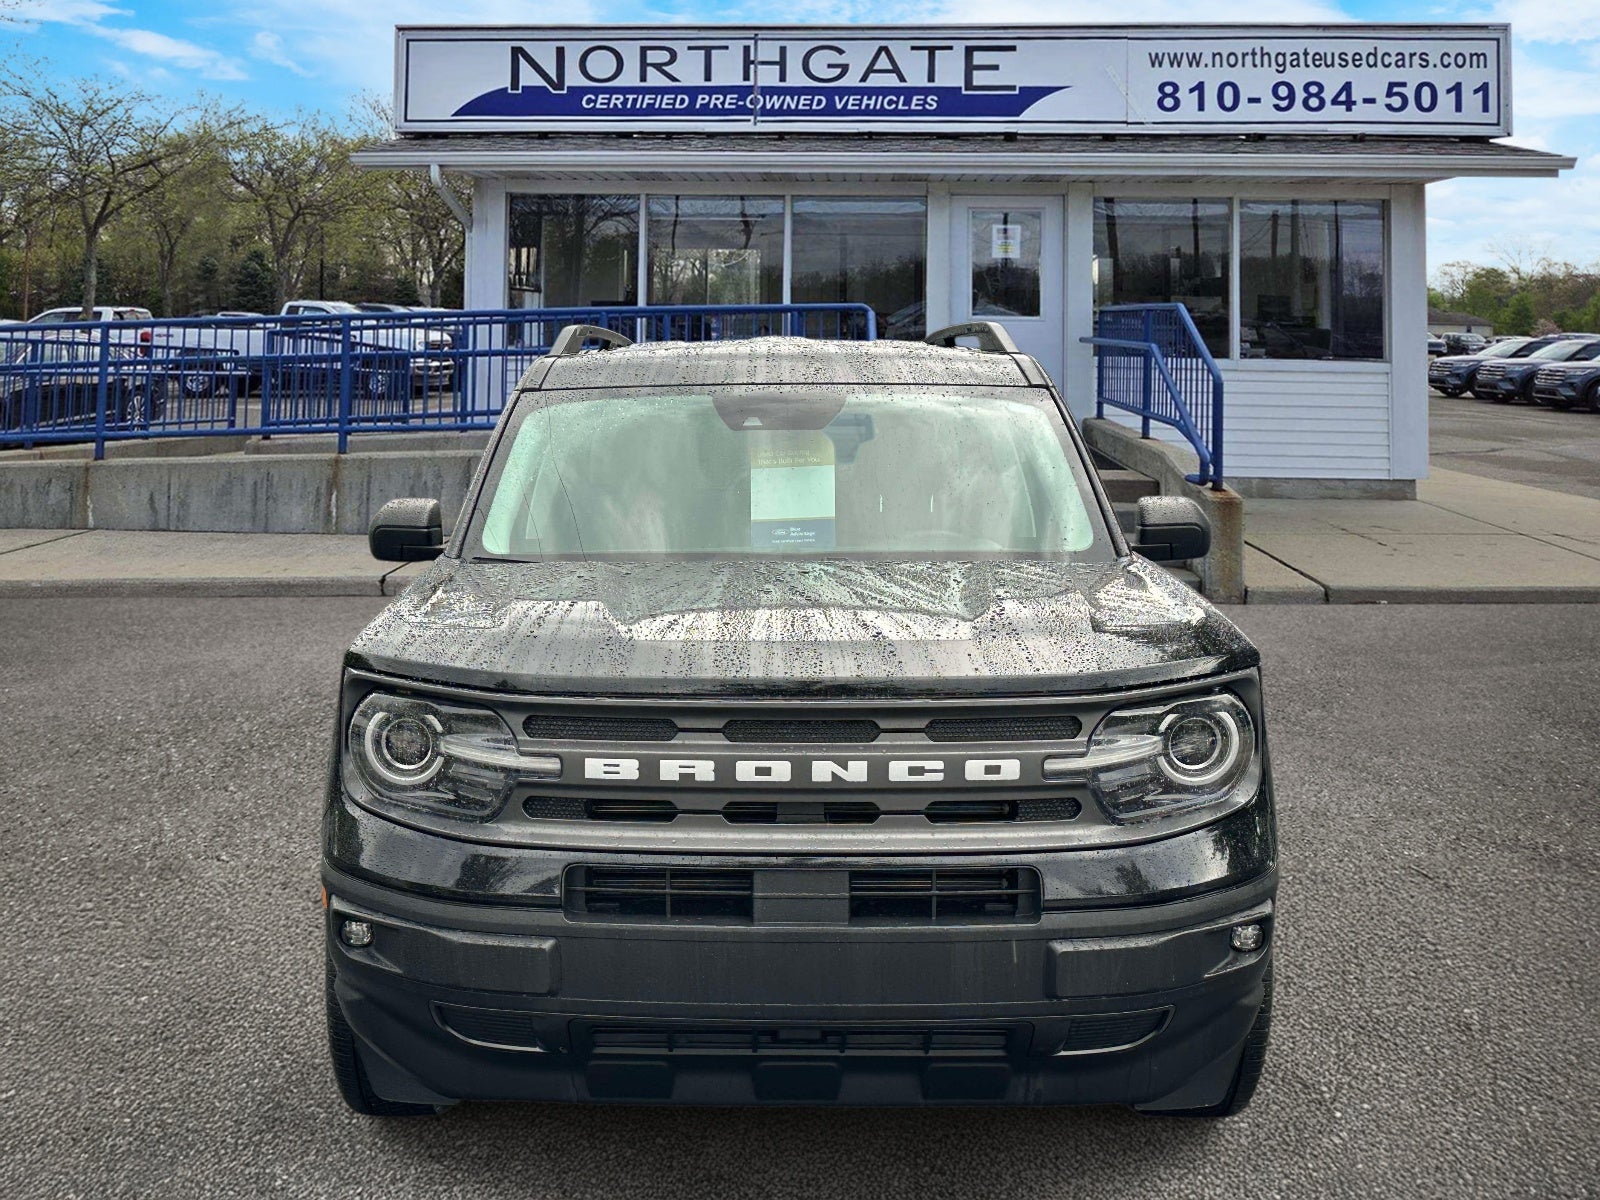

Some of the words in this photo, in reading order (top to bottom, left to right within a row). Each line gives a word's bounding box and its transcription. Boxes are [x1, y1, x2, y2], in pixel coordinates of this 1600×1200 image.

[510, 45, 1018, 92] NORTHGATE
[1149, 46, 1489, 74] www.northgateusedcars.com
[581, 94, 689, 110] CERTIFIED
[695, 94, 827, 111] PRE-OWNED
[833, 95, 939, 111] VEHICLES
[1156, 80, 1491, 114] 810-984-5011
[584, 758, 1021, 782] BRONCO
